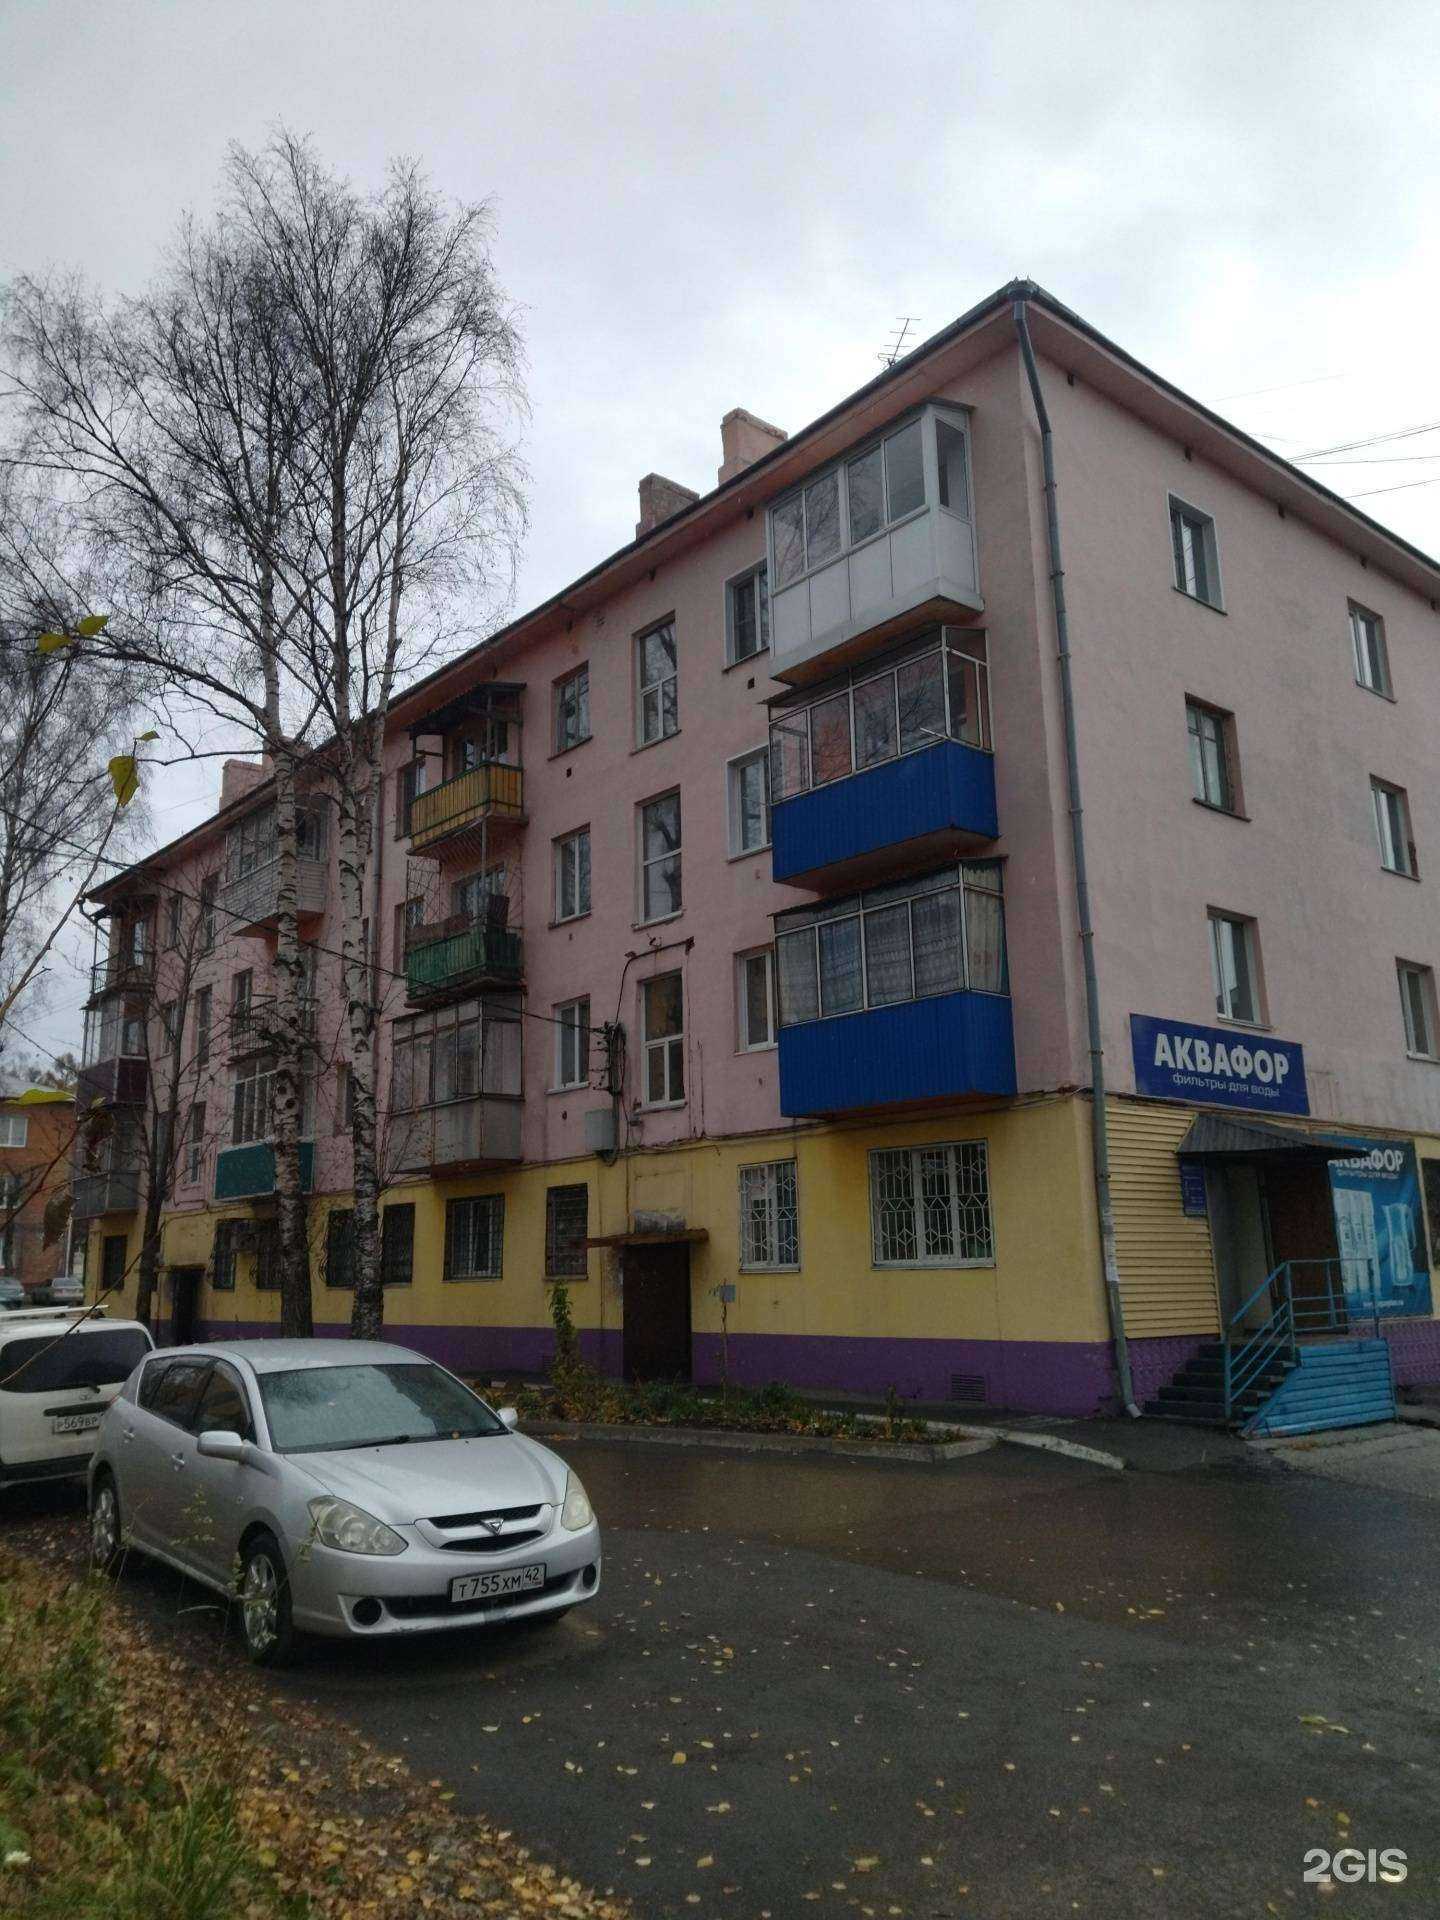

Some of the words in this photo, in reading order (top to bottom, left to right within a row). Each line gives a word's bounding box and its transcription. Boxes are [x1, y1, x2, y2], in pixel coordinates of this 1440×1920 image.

[1154, 1033, 1290, 1084] АКВАФОР
[1172, 1072, 1227, 1091] фильтры
[1228, 1081, 1249, 1093] для
[1251, 1086, 1280, 1098] воды
